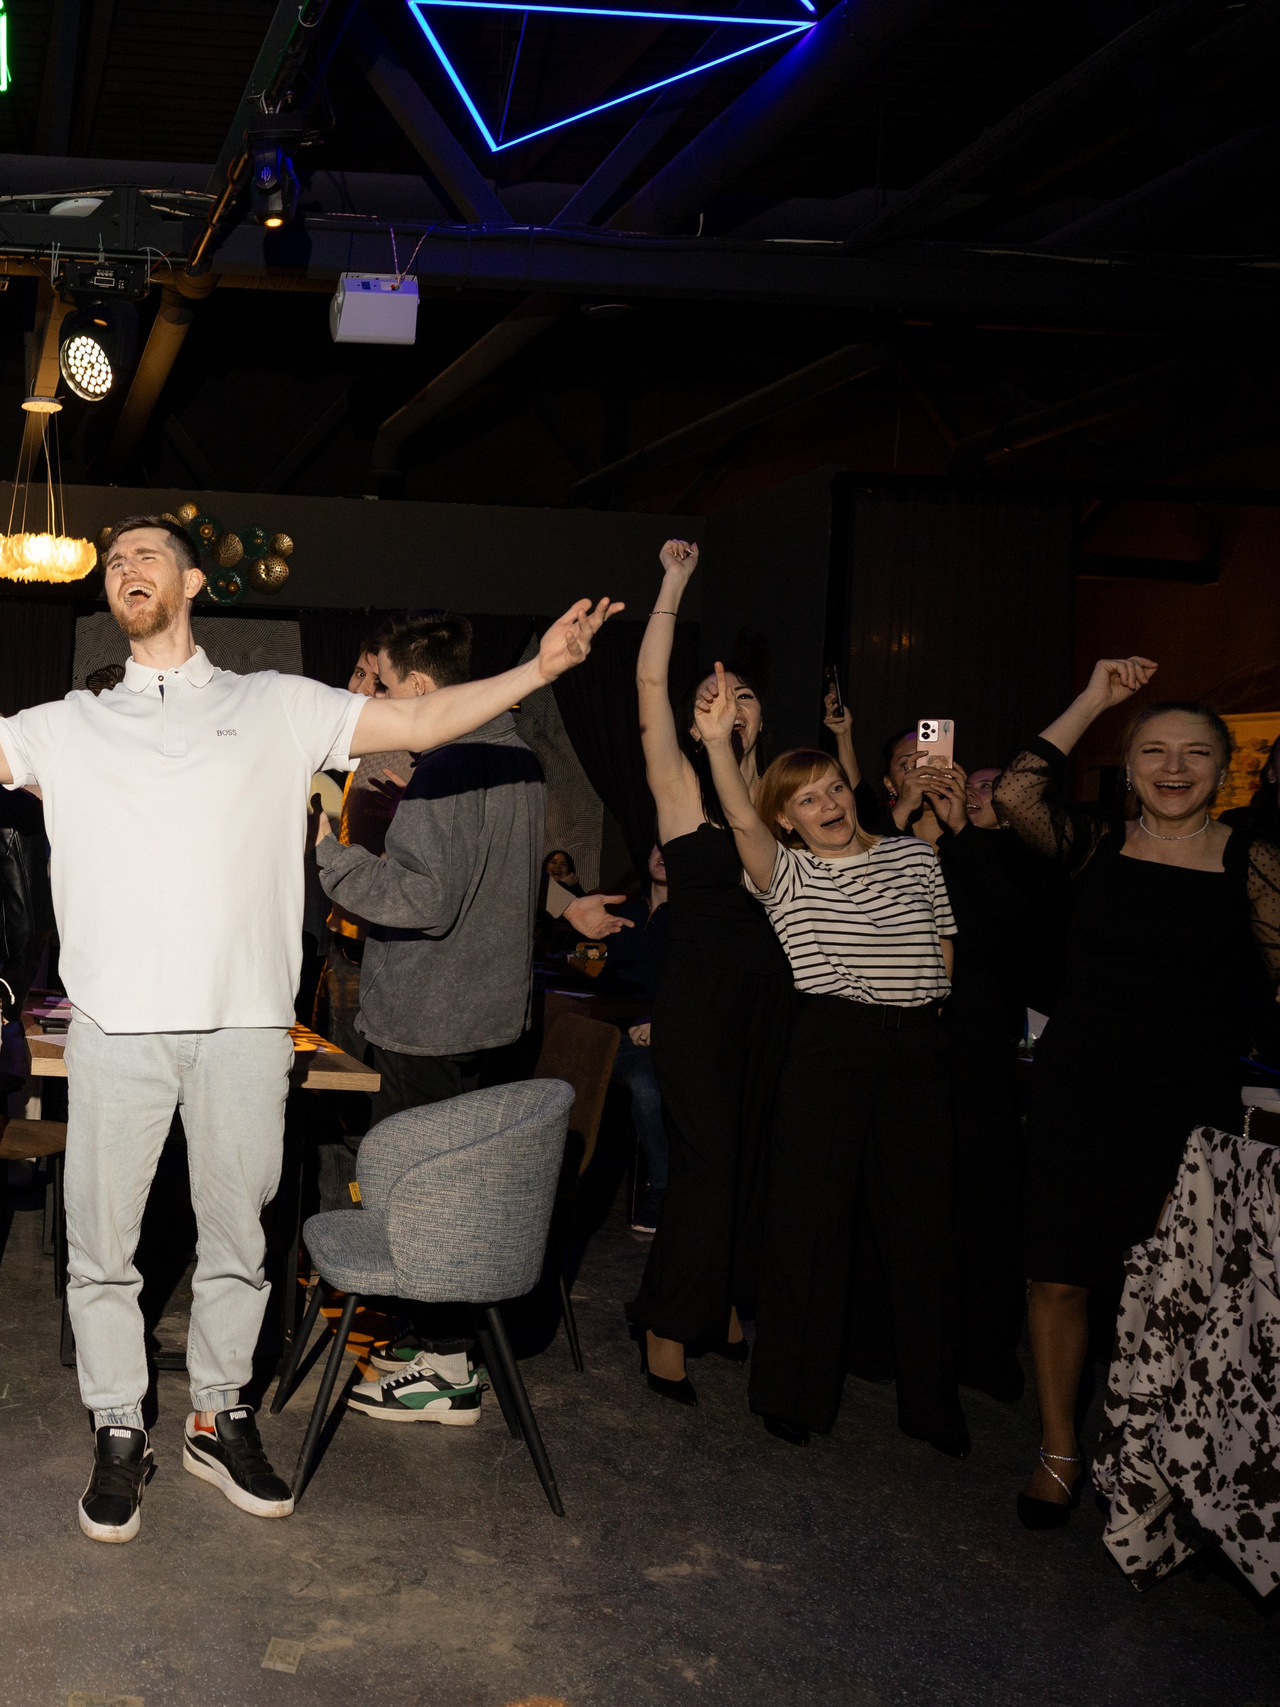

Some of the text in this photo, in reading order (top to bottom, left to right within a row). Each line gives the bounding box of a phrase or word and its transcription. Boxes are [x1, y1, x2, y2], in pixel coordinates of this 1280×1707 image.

[216, 729, 238, 737] BOSS
[229, 1410, 248, 1421] PUMA
[109, 1428, 132, 1439] PUMA
